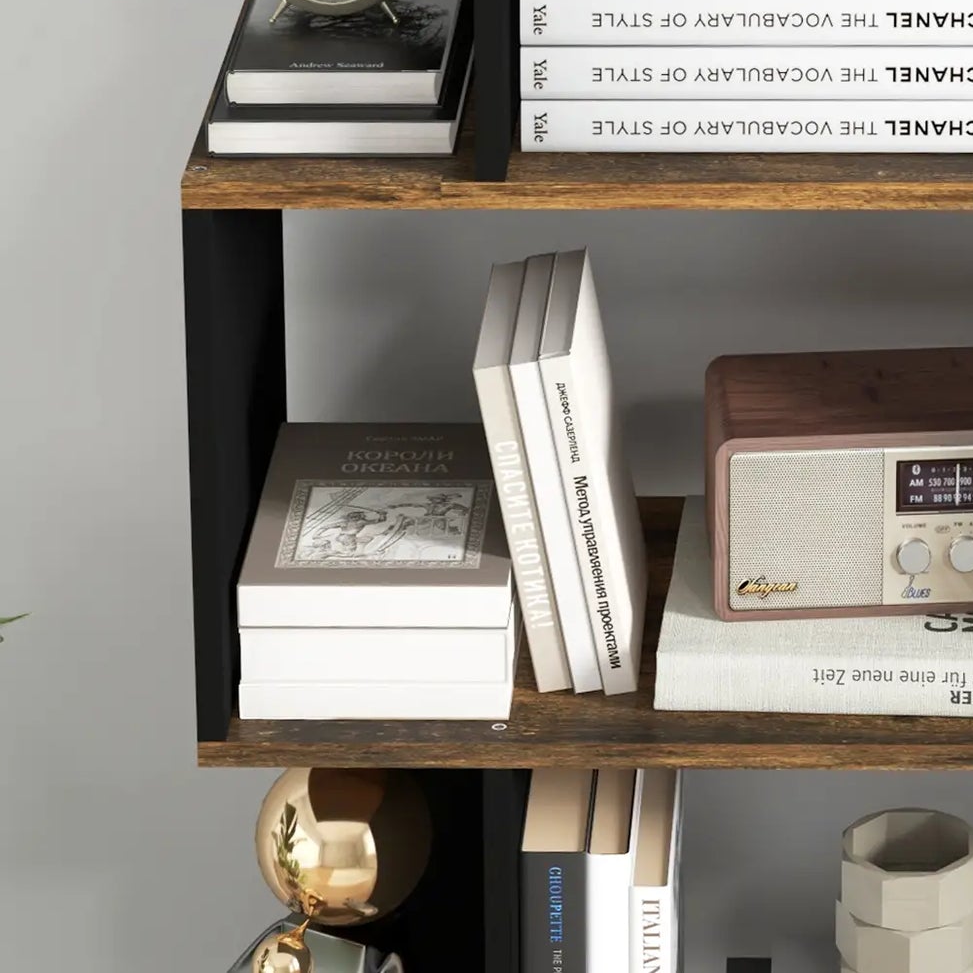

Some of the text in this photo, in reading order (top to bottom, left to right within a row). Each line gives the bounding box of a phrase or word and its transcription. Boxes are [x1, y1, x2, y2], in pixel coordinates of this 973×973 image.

[533, 5, 547, 36] Yale
[592, 12, 653, 27] STYLE
[660, 12, 687, 27] OF
[694, 12, 833, 27] VOCABULARY
[841, 12, 879, 27] THE
[533, 60, 547, 90] Yale
[592, 67, 653, 82] STYLE
[660, 67, 687, 82] OF
[694, 67, 833, 82] VOCABULARY
[840, 67, 878, 82] THE
[534, 113, 548, 143] Yale
[592, 120, 653, 135] STYLE
[660, 120, 687, 135] OF
[694, 120, 832, 135] VOCABULARY
[839, 120, 878, 135] THE
[555, 382, 580, 464] ДЖЕФФ САЗЕРЛЕНД
[347, 450, 455, 461] КОРОЛИ
[341, 463, 449, 474] ОКЕАНА
[909, 478, 924, 487] AM
[928, 477, 941, 487] 530
[943, 477, 955, 486] 700
[960, 476, 972, 485] 900
[910, 494, 923, 503] FM
[933, 494, 942, 503] 88
[943, 493, 952, 502] 90
[963, 493, 972, 502] 94
[495, 440, 555, 629] СПАСИТЕ КОТИКА!
[573, 475, 592, 518] Метод
[597, 600, 622, 669] проектами
[813, 668, 846, 686] Zeit
[852, 669, 893, 682] neue
[900, 670, 936, 687] eine
[941, 670, 966, 688] für
[549, 866, 563, 943] CHOUPETTE
[553, 949, 562, 965] THE
